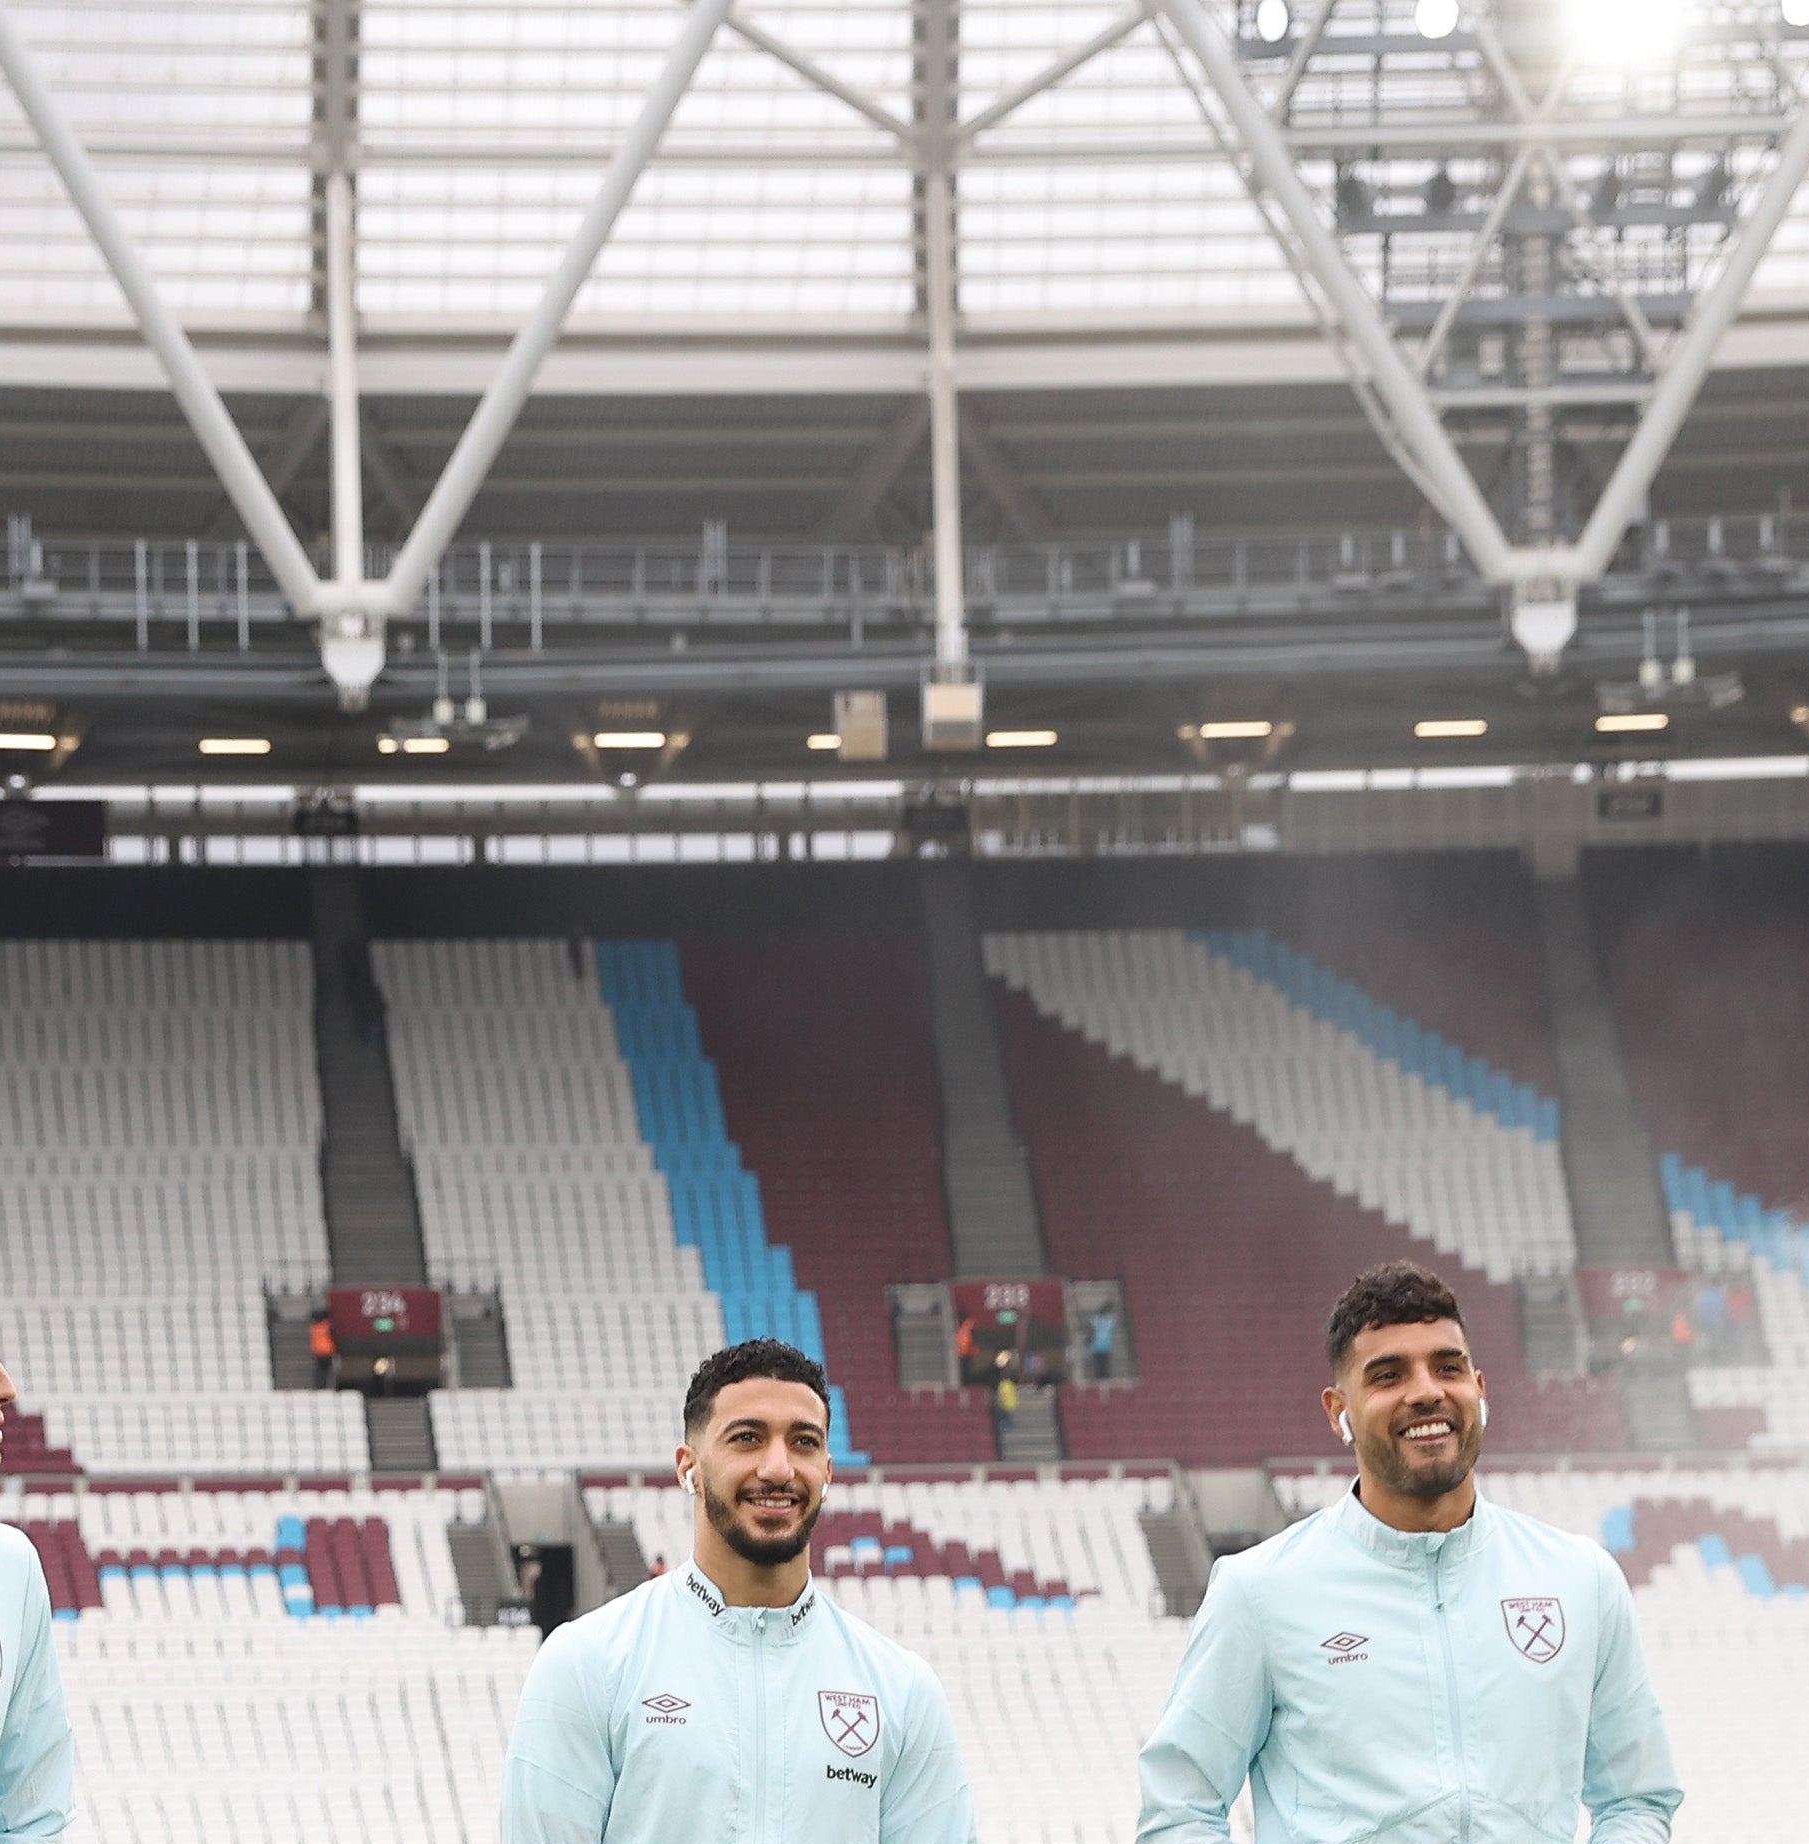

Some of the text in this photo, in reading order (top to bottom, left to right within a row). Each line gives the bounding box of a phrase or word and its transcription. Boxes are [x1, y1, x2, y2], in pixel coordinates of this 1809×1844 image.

[686, 1573, 724, 1617] betway
[1328, 1652, 1368, 1665] umbro
[825, 1694, 871, 1706] WEST HAM
[646, 1714, 686, 1725] umbro
[826, 1764, 878, 1788] betway
